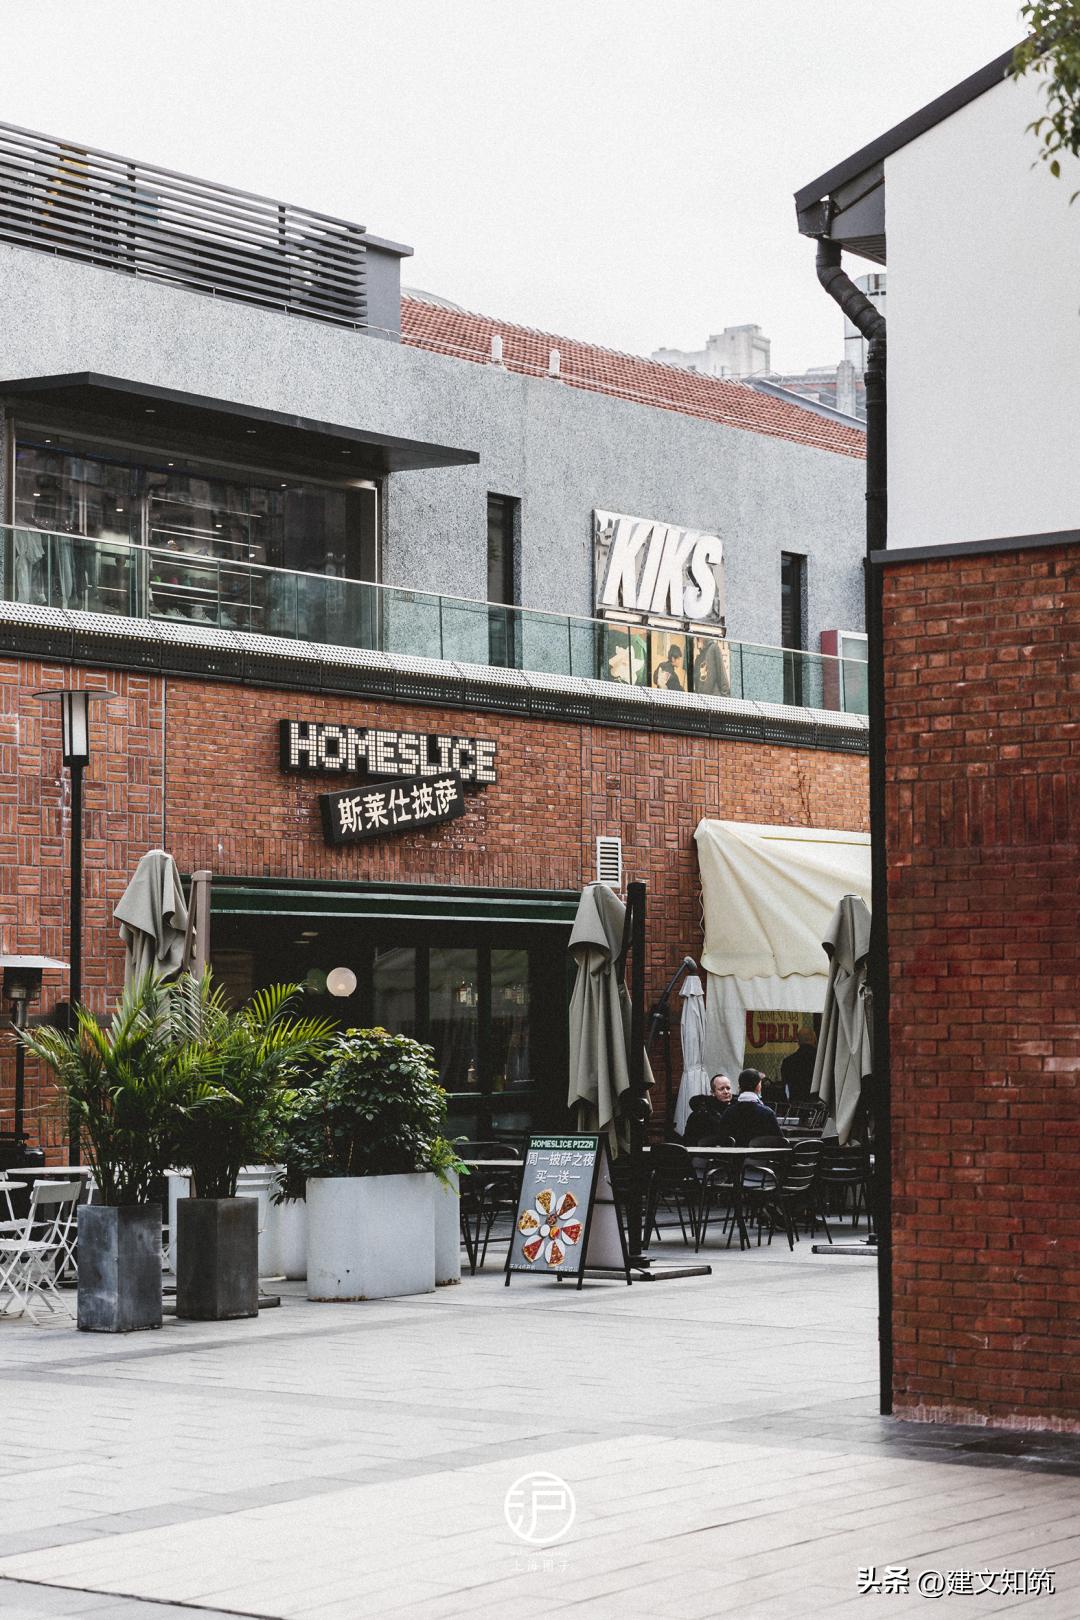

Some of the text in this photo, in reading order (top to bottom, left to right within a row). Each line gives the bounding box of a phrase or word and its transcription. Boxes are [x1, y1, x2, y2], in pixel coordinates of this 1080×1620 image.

[602, 517, 723, 619] KIKS
[290, 722, 496, 781] HOMESLICE
[337, 778, 459, 834] 斯莱仕披萨
[526, 1152, 595, 1168] 周一披萨之夜
[530, 1140, 594, 1149] HOMESLICE PIZZA
[535, 1170, 581, 1184] 买一送一
